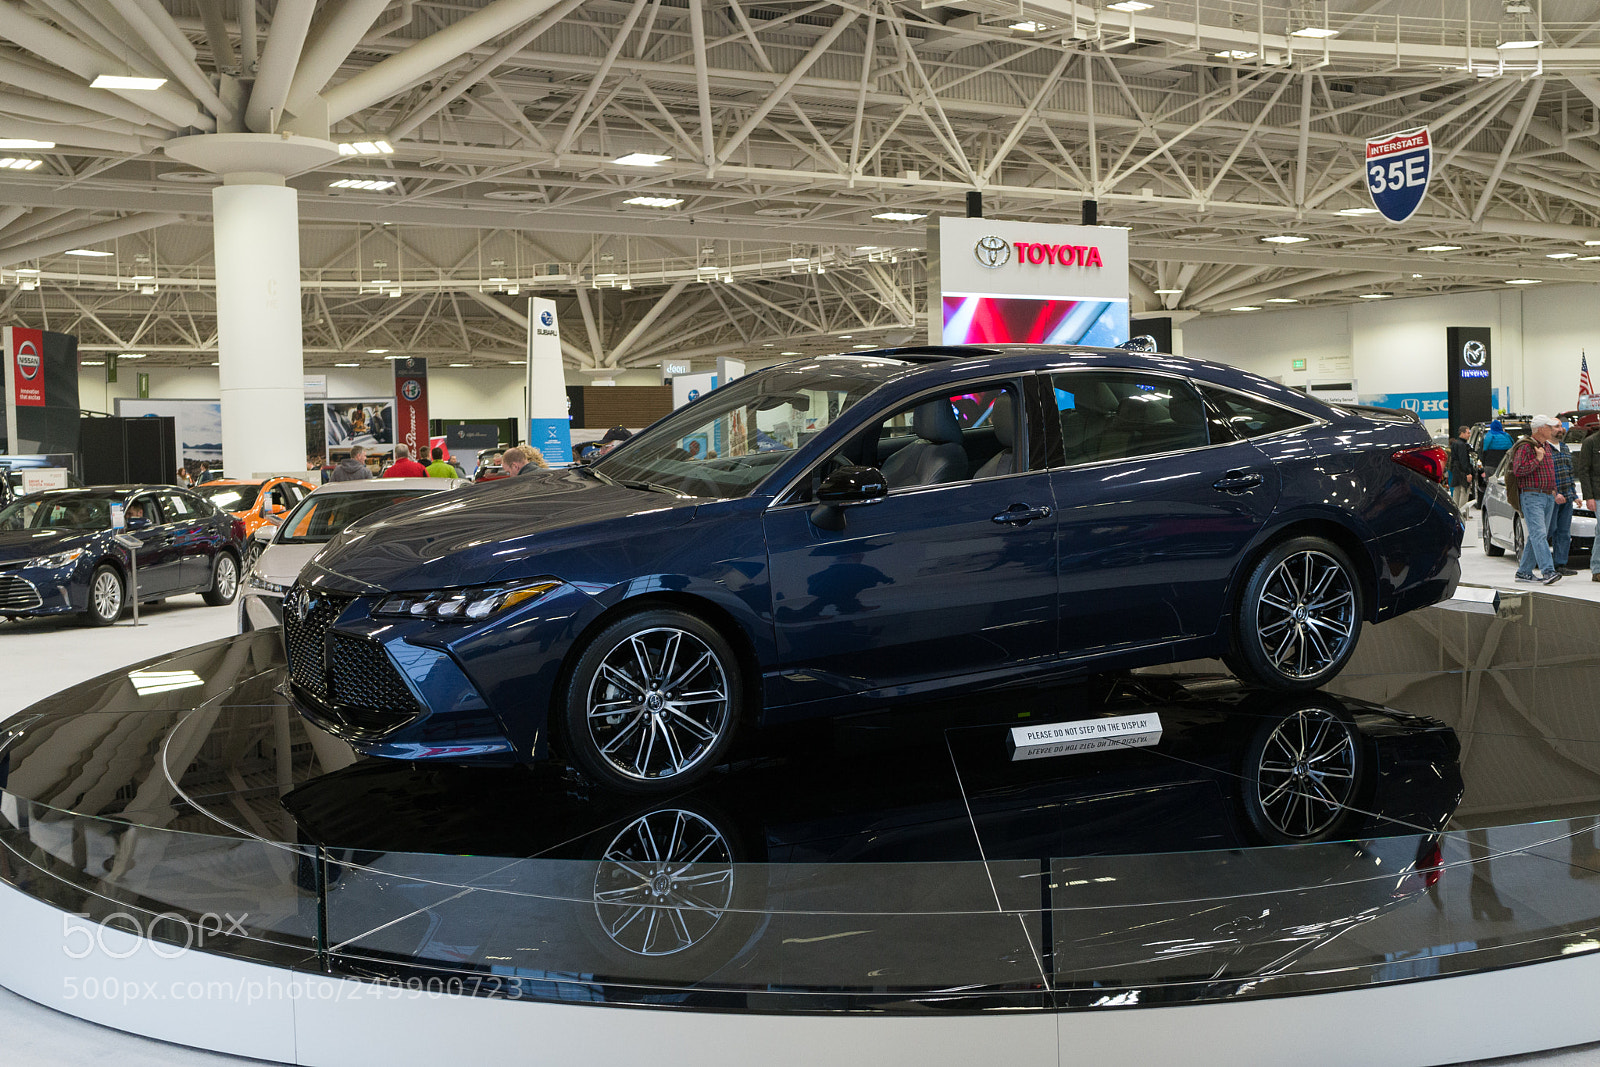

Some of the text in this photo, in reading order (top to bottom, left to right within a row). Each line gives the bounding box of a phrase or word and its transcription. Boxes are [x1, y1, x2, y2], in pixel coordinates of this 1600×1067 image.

[1371, 136, 1424, 155] INTERSTATE
[1370, 156, 1426, 193] 35E
[1013, 242, 1103, 267] TOYOTA
[537, 328, 557, 336] SUBARU
[19, 356, 39, 365] NISSAN
[405, 405, 417, 447] Romeo
[1027, 730, 1052, 740] PLEASE
[1065, 728, 1077, 736] NOT
[1079, 725, 1095, 735] STEP
[1097, 724, 1107, 732] ON
[1107, 722, 1120, 731] THE
[1121, 720, 1147, 730] DISPLAY
